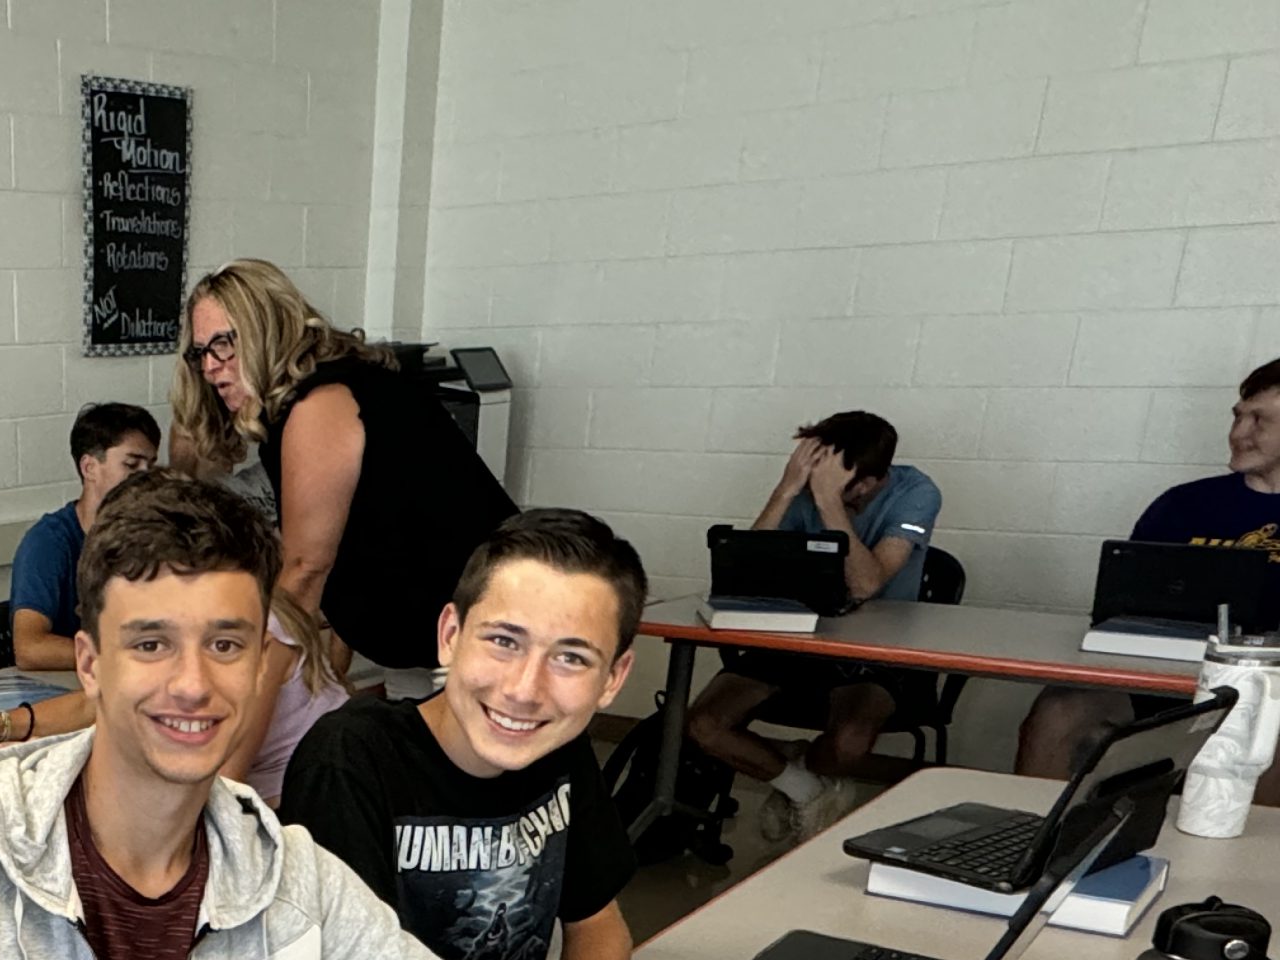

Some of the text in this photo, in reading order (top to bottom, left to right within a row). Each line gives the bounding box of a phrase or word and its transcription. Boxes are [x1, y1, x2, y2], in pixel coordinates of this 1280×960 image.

[93, 93, 146, 150] Rigid
[121, 138, 186, 174] Motion
[103, 170, 181, 207] Reflections
[106, 242, 169, 273] Rotations
